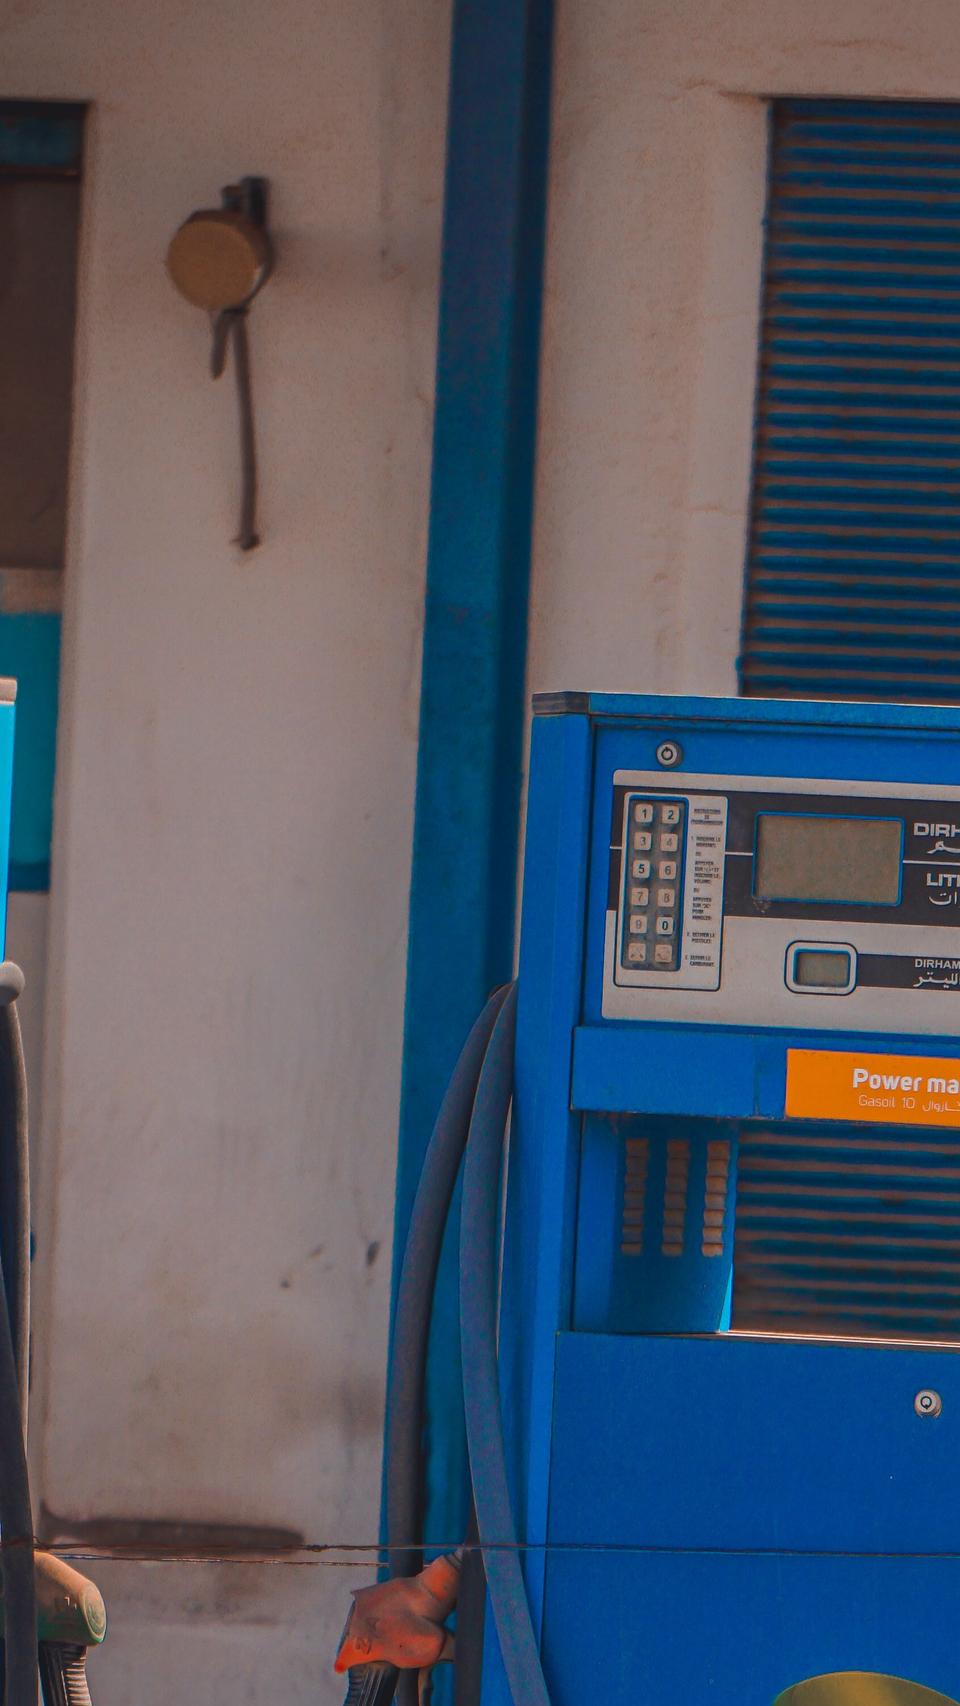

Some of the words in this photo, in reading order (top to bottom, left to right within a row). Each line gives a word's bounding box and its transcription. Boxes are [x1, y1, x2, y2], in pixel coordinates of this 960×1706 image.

[667, 809, 674, 820] 2
[638, 863, 645, 874] 5
[664, 865, 671, 875] 6
[661, 920, 669, 931] 0
[852, 1068, 923, 1092] Power
[858, 1094, 896, 1109] Gasoil
[903, 1097, 916, 1109] 10
